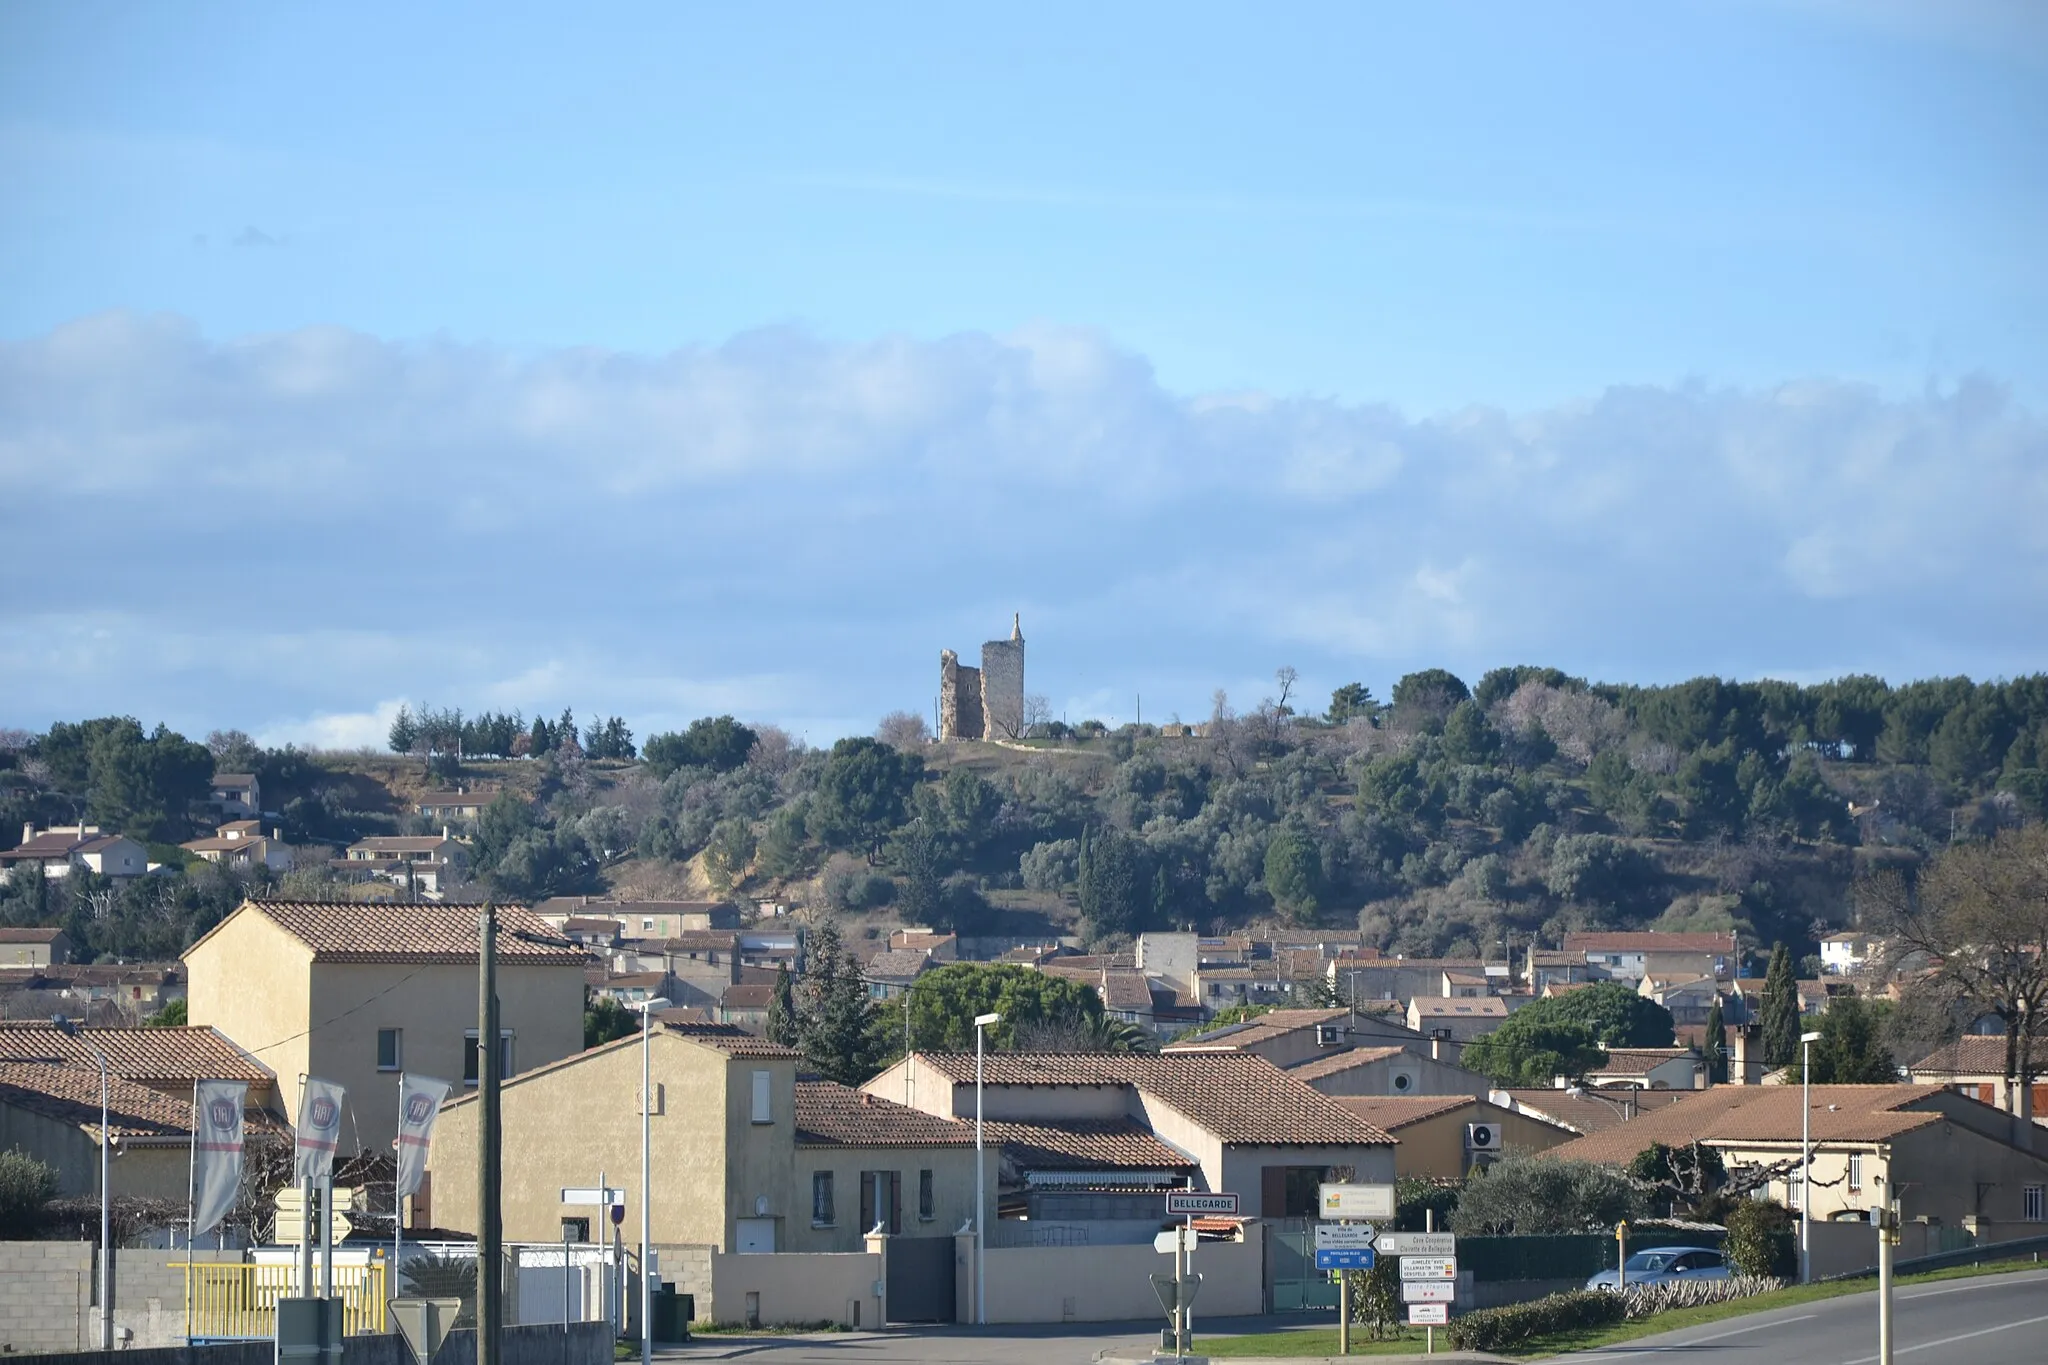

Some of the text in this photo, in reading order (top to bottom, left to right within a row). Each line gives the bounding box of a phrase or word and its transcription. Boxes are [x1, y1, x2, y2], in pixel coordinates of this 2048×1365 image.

[212, 1106, 234, 1123] FIAT
[313, 1103, 333, 1122] FIAT
[409, 1100, 429, 1118] FIAT
[1174, 1199, 1232, 1208] BELLEGARDE
[1428, 1245, 1452, 1254] Bellegarde
